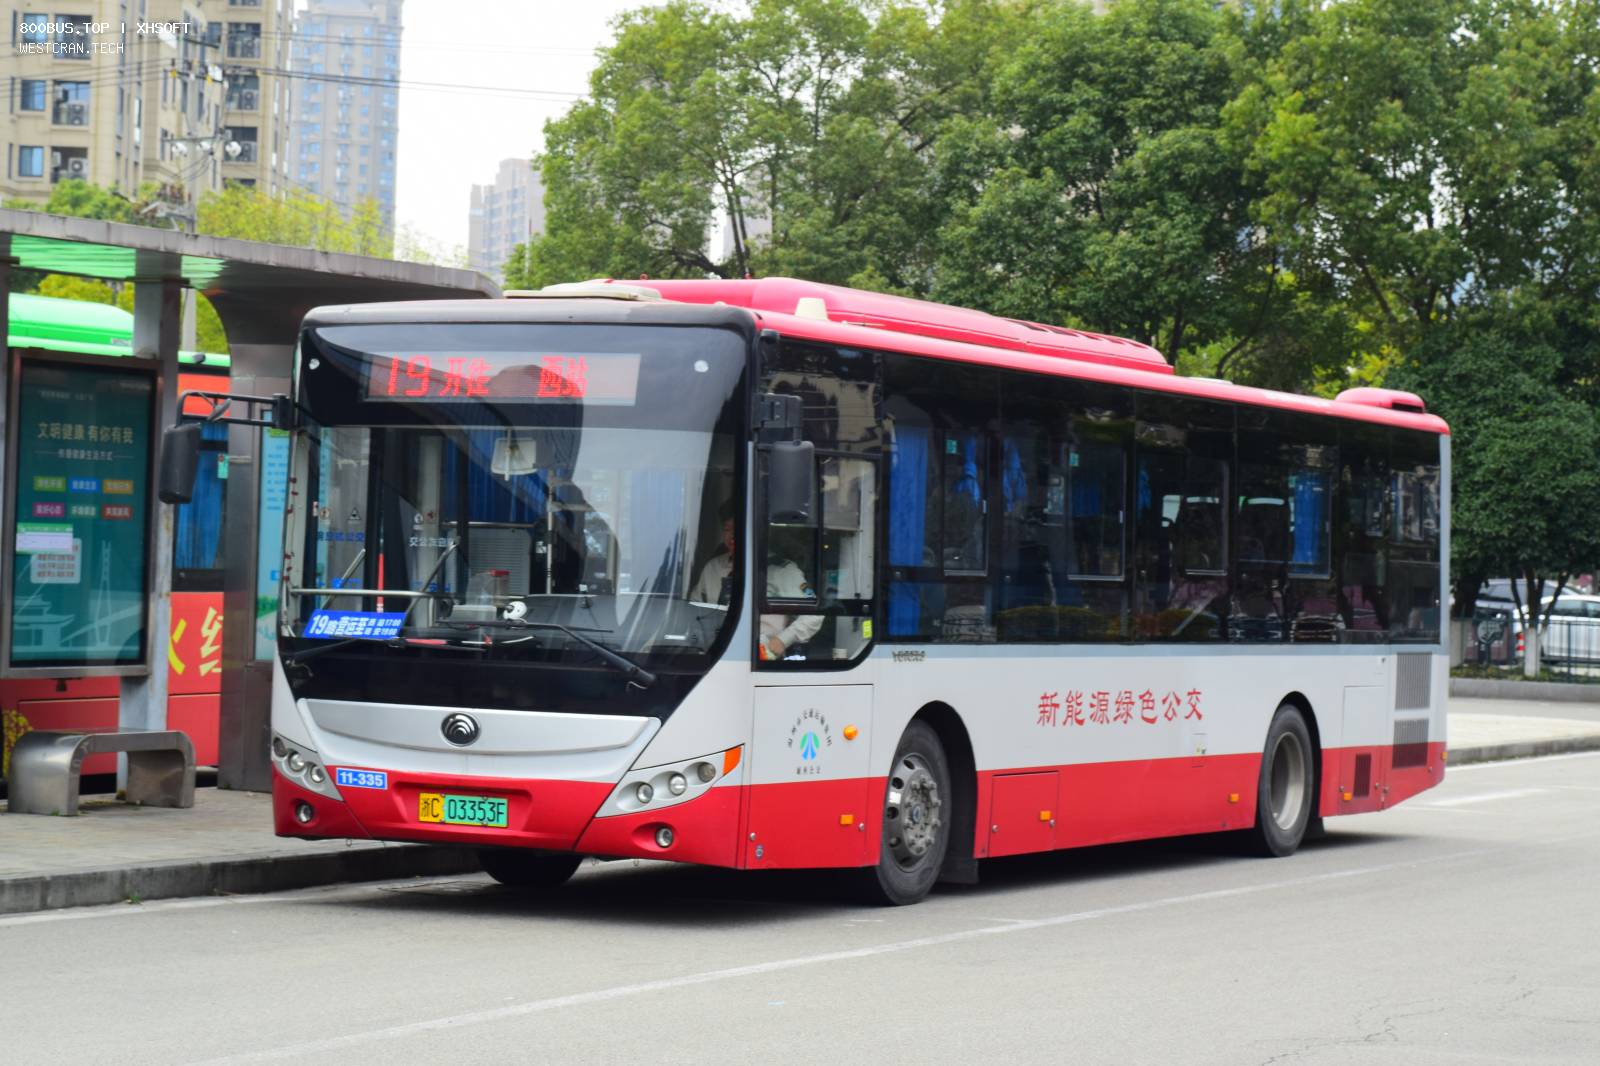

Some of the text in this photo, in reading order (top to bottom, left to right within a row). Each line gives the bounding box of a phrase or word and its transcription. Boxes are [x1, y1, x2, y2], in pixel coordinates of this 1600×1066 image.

[386, 354, 432, 397] 19
[38, 421, 134, 444] 文明健康 有你有我
[1037, 688, 1203, 727] 新能源绿色公交
[339, 771, 384, 787] 11-335
[448, 799, 506, 823] 03353F
